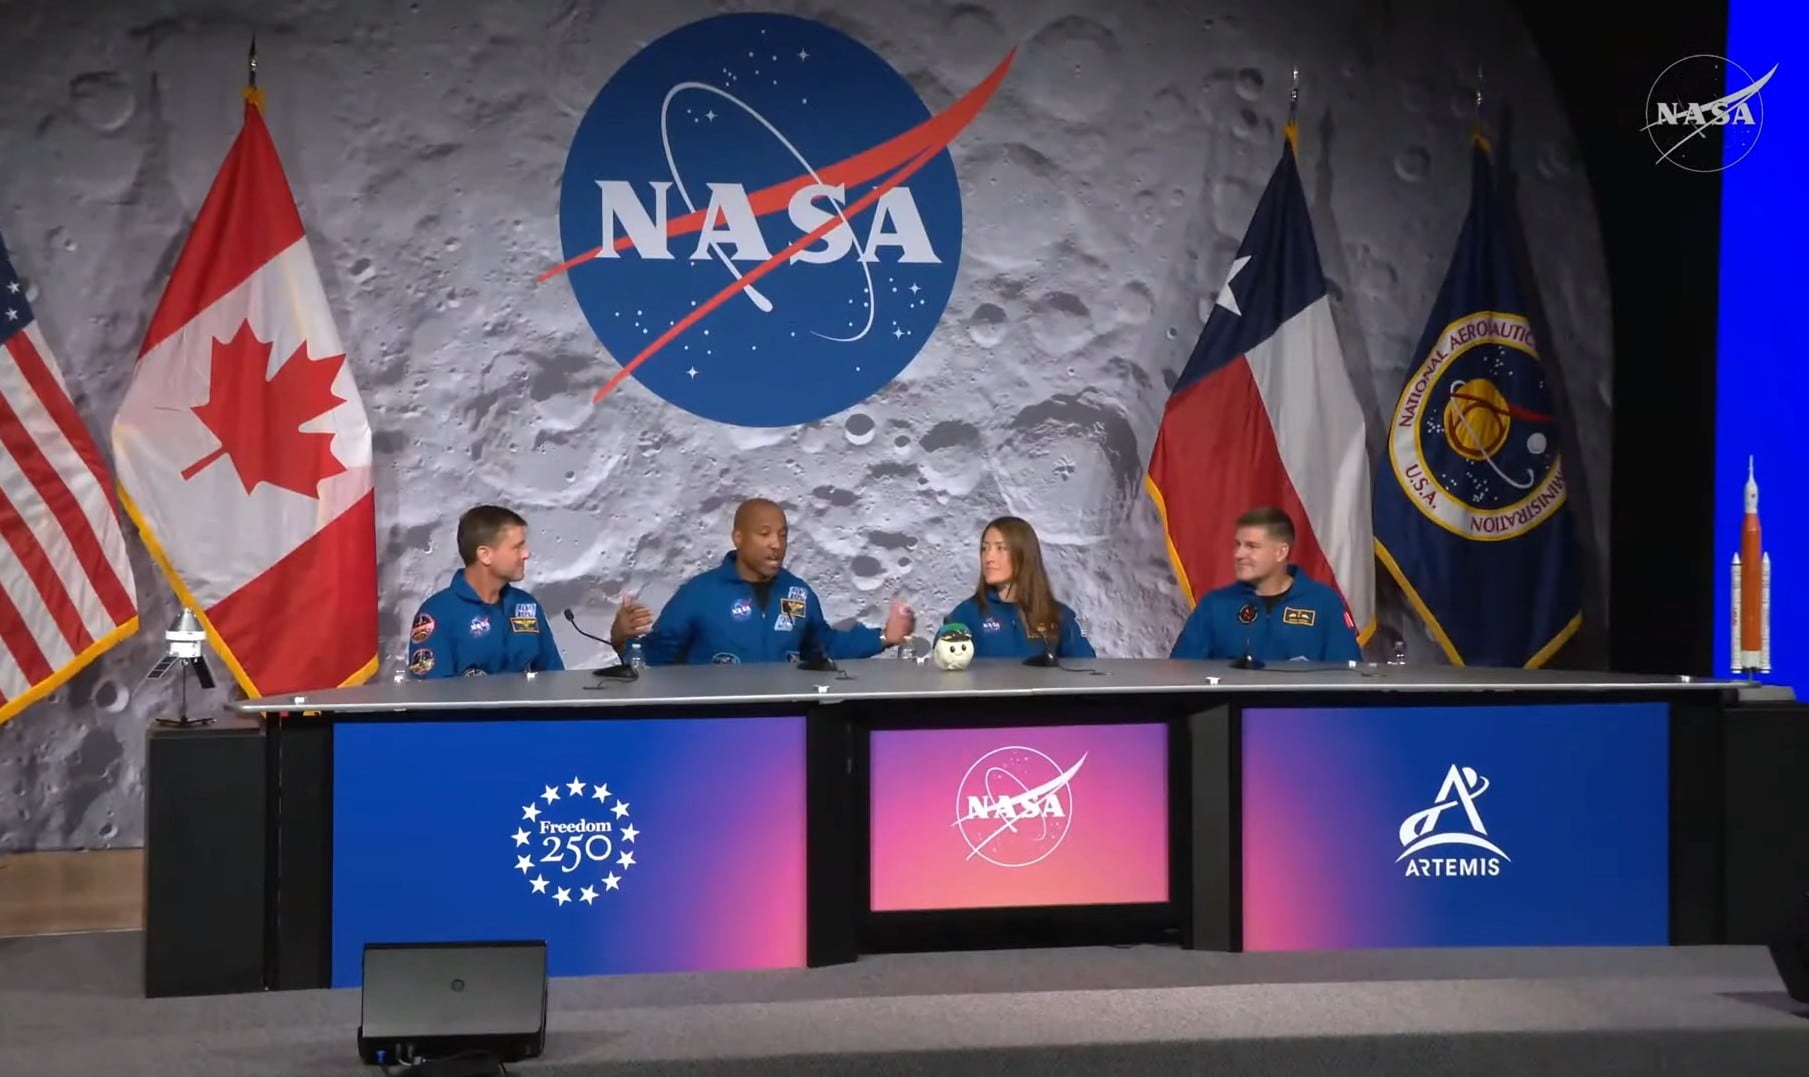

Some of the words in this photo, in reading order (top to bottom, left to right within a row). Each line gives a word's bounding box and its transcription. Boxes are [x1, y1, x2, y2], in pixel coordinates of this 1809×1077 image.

[594, 179, 943, 266] NASA
[1399, 350, 1448, 428] NATIONAL
[1450, 320, 1536, 351] AEROAUTIC
[1405, 463, 1437, 509] U.S.A.
[539, 818, 612, 834] Freedom
[966, 794, 1066, 819] NASA
[540, 834, 612, 873] 250
[1405, 857, 1500, 877] ARTEMIS
